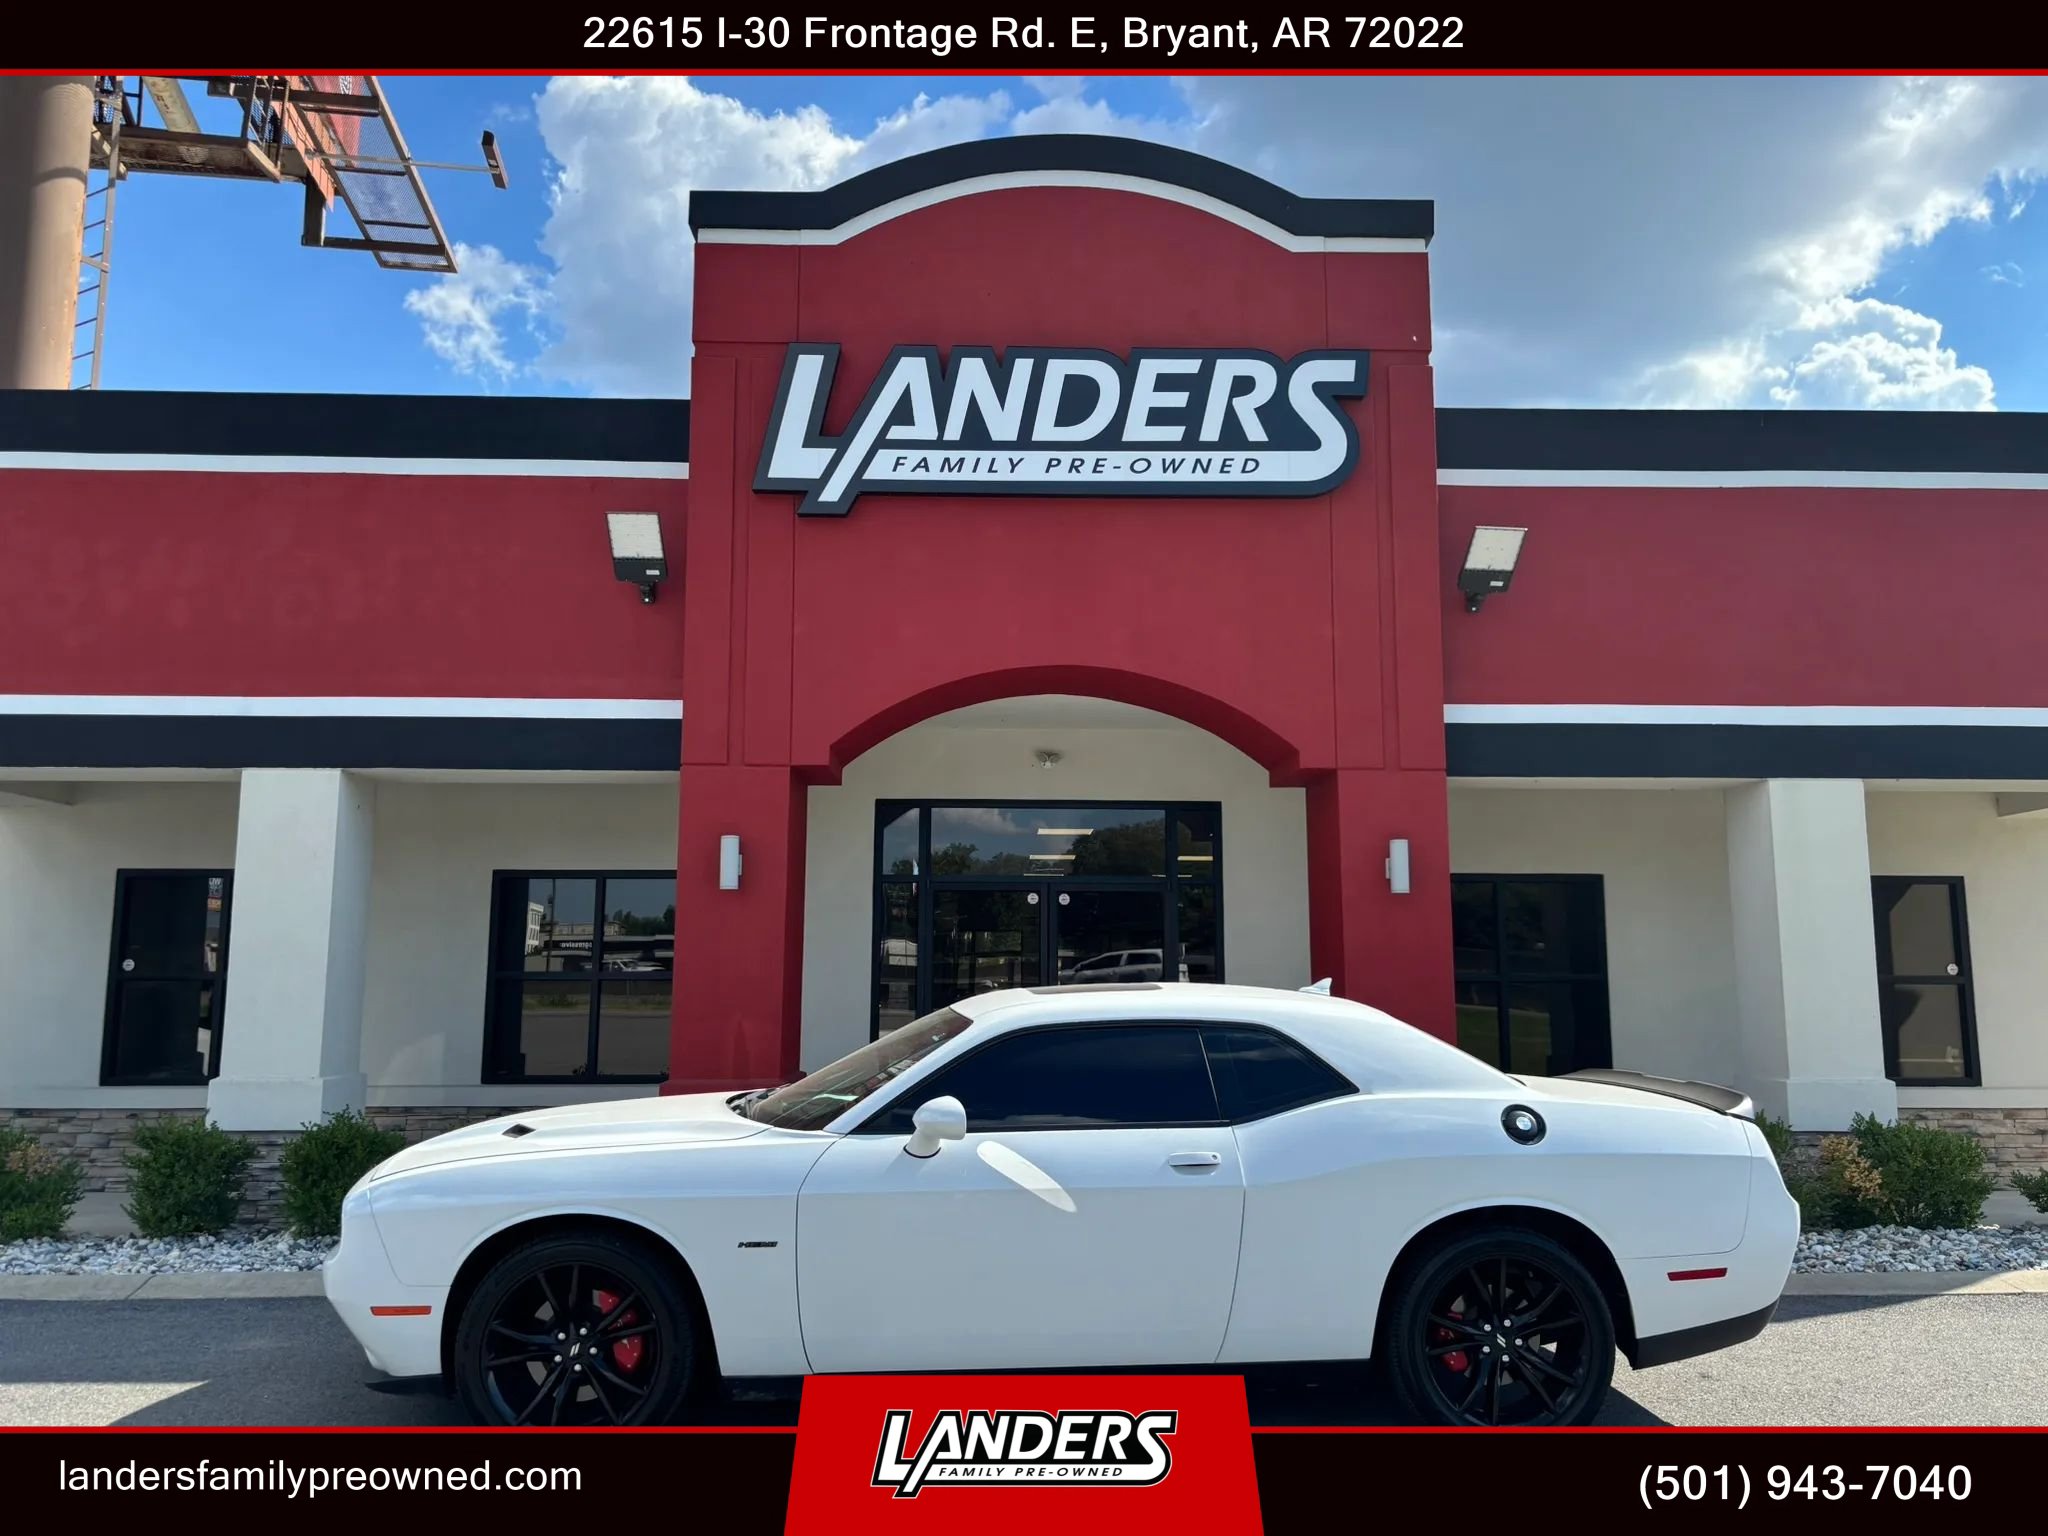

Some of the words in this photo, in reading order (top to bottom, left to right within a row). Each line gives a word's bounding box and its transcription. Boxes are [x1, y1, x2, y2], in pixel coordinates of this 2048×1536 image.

[767, 353, 1357, 503] LANDERS
[891, 455, 1027, 475] FAMILY
[1044, 456, 1262, 475] PRE-OWNED
